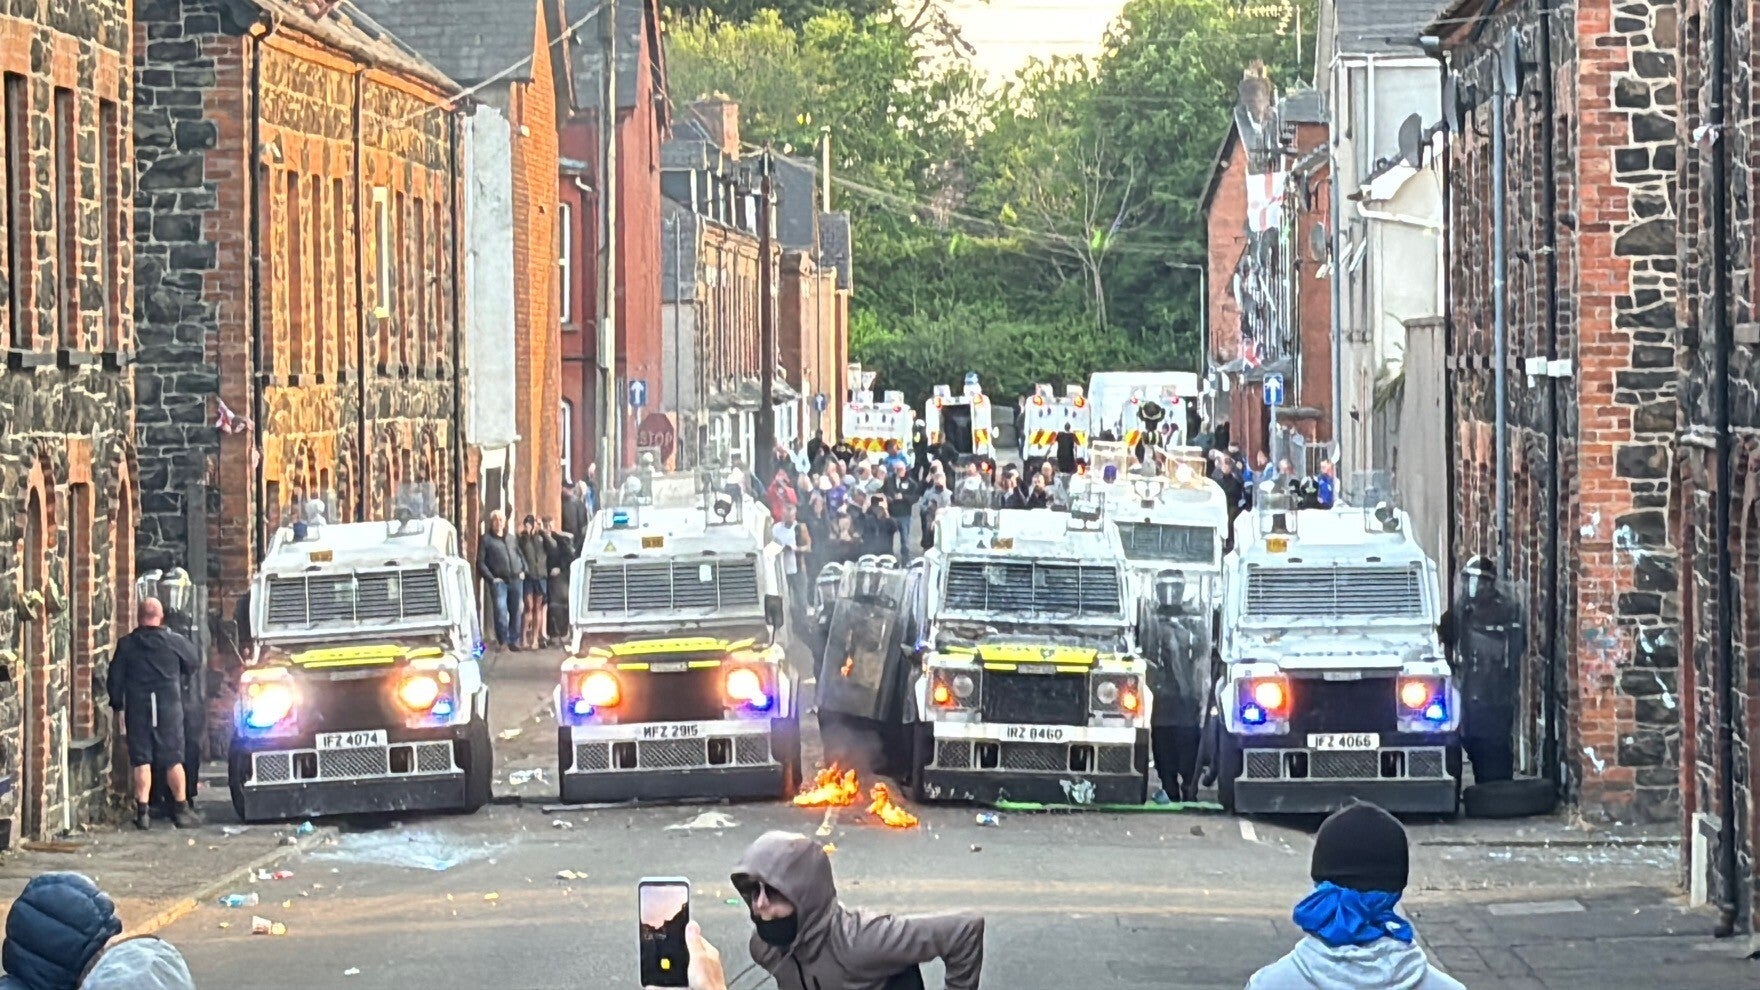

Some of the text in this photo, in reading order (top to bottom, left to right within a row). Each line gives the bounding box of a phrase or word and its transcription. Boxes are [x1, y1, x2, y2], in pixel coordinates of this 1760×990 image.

[639, 430, 673, 447] STOP
[671, 724, 698, 737] 2915
[323, 732, 378, 748] IFZ 4074
[1316, 736, 1335, 747] IFZ
